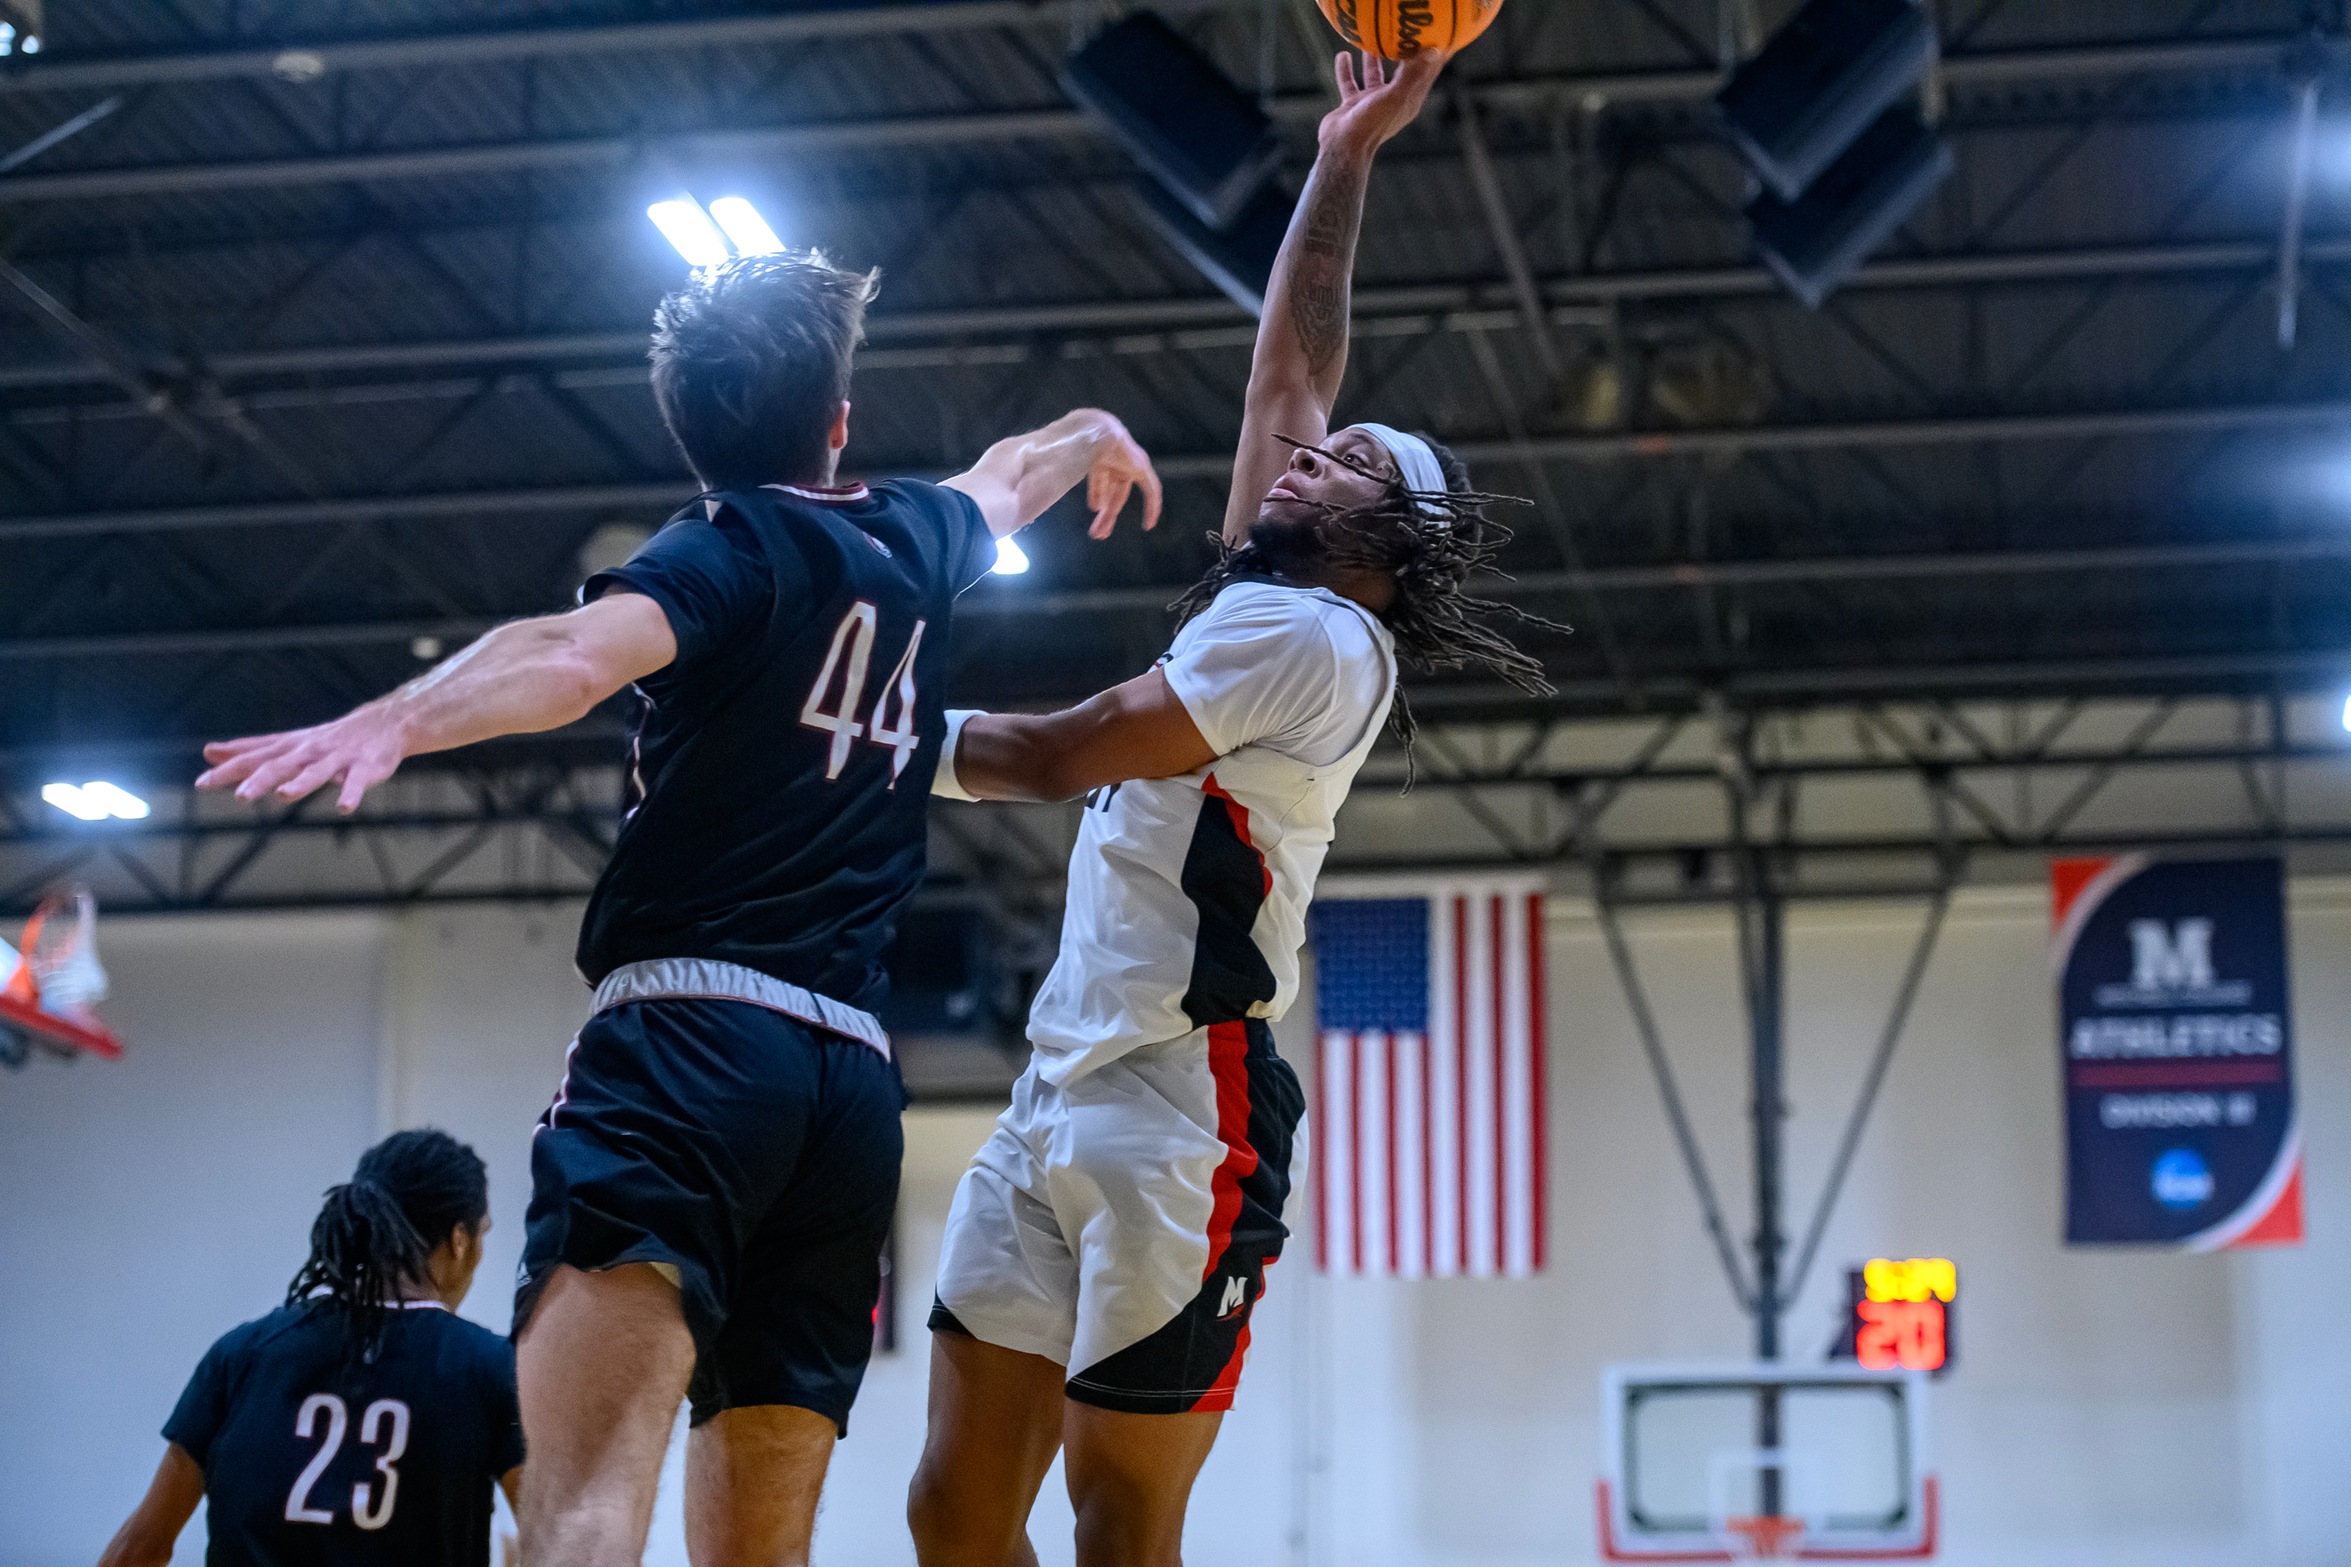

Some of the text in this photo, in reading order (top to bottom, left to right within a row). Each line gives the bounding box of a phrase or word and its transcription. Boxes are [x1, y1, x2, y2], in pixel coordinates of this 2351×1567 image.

[800, 600, 926, 790] 44
[2129, 918, 2213, 988] M
[2071, 1013, 2282, 1059] ATHLETICS
[1217, 1276, 1248, 1317] M
[1857, 1300, 1945, 1370] 20
[285, 1393, 411, 1530] 23
